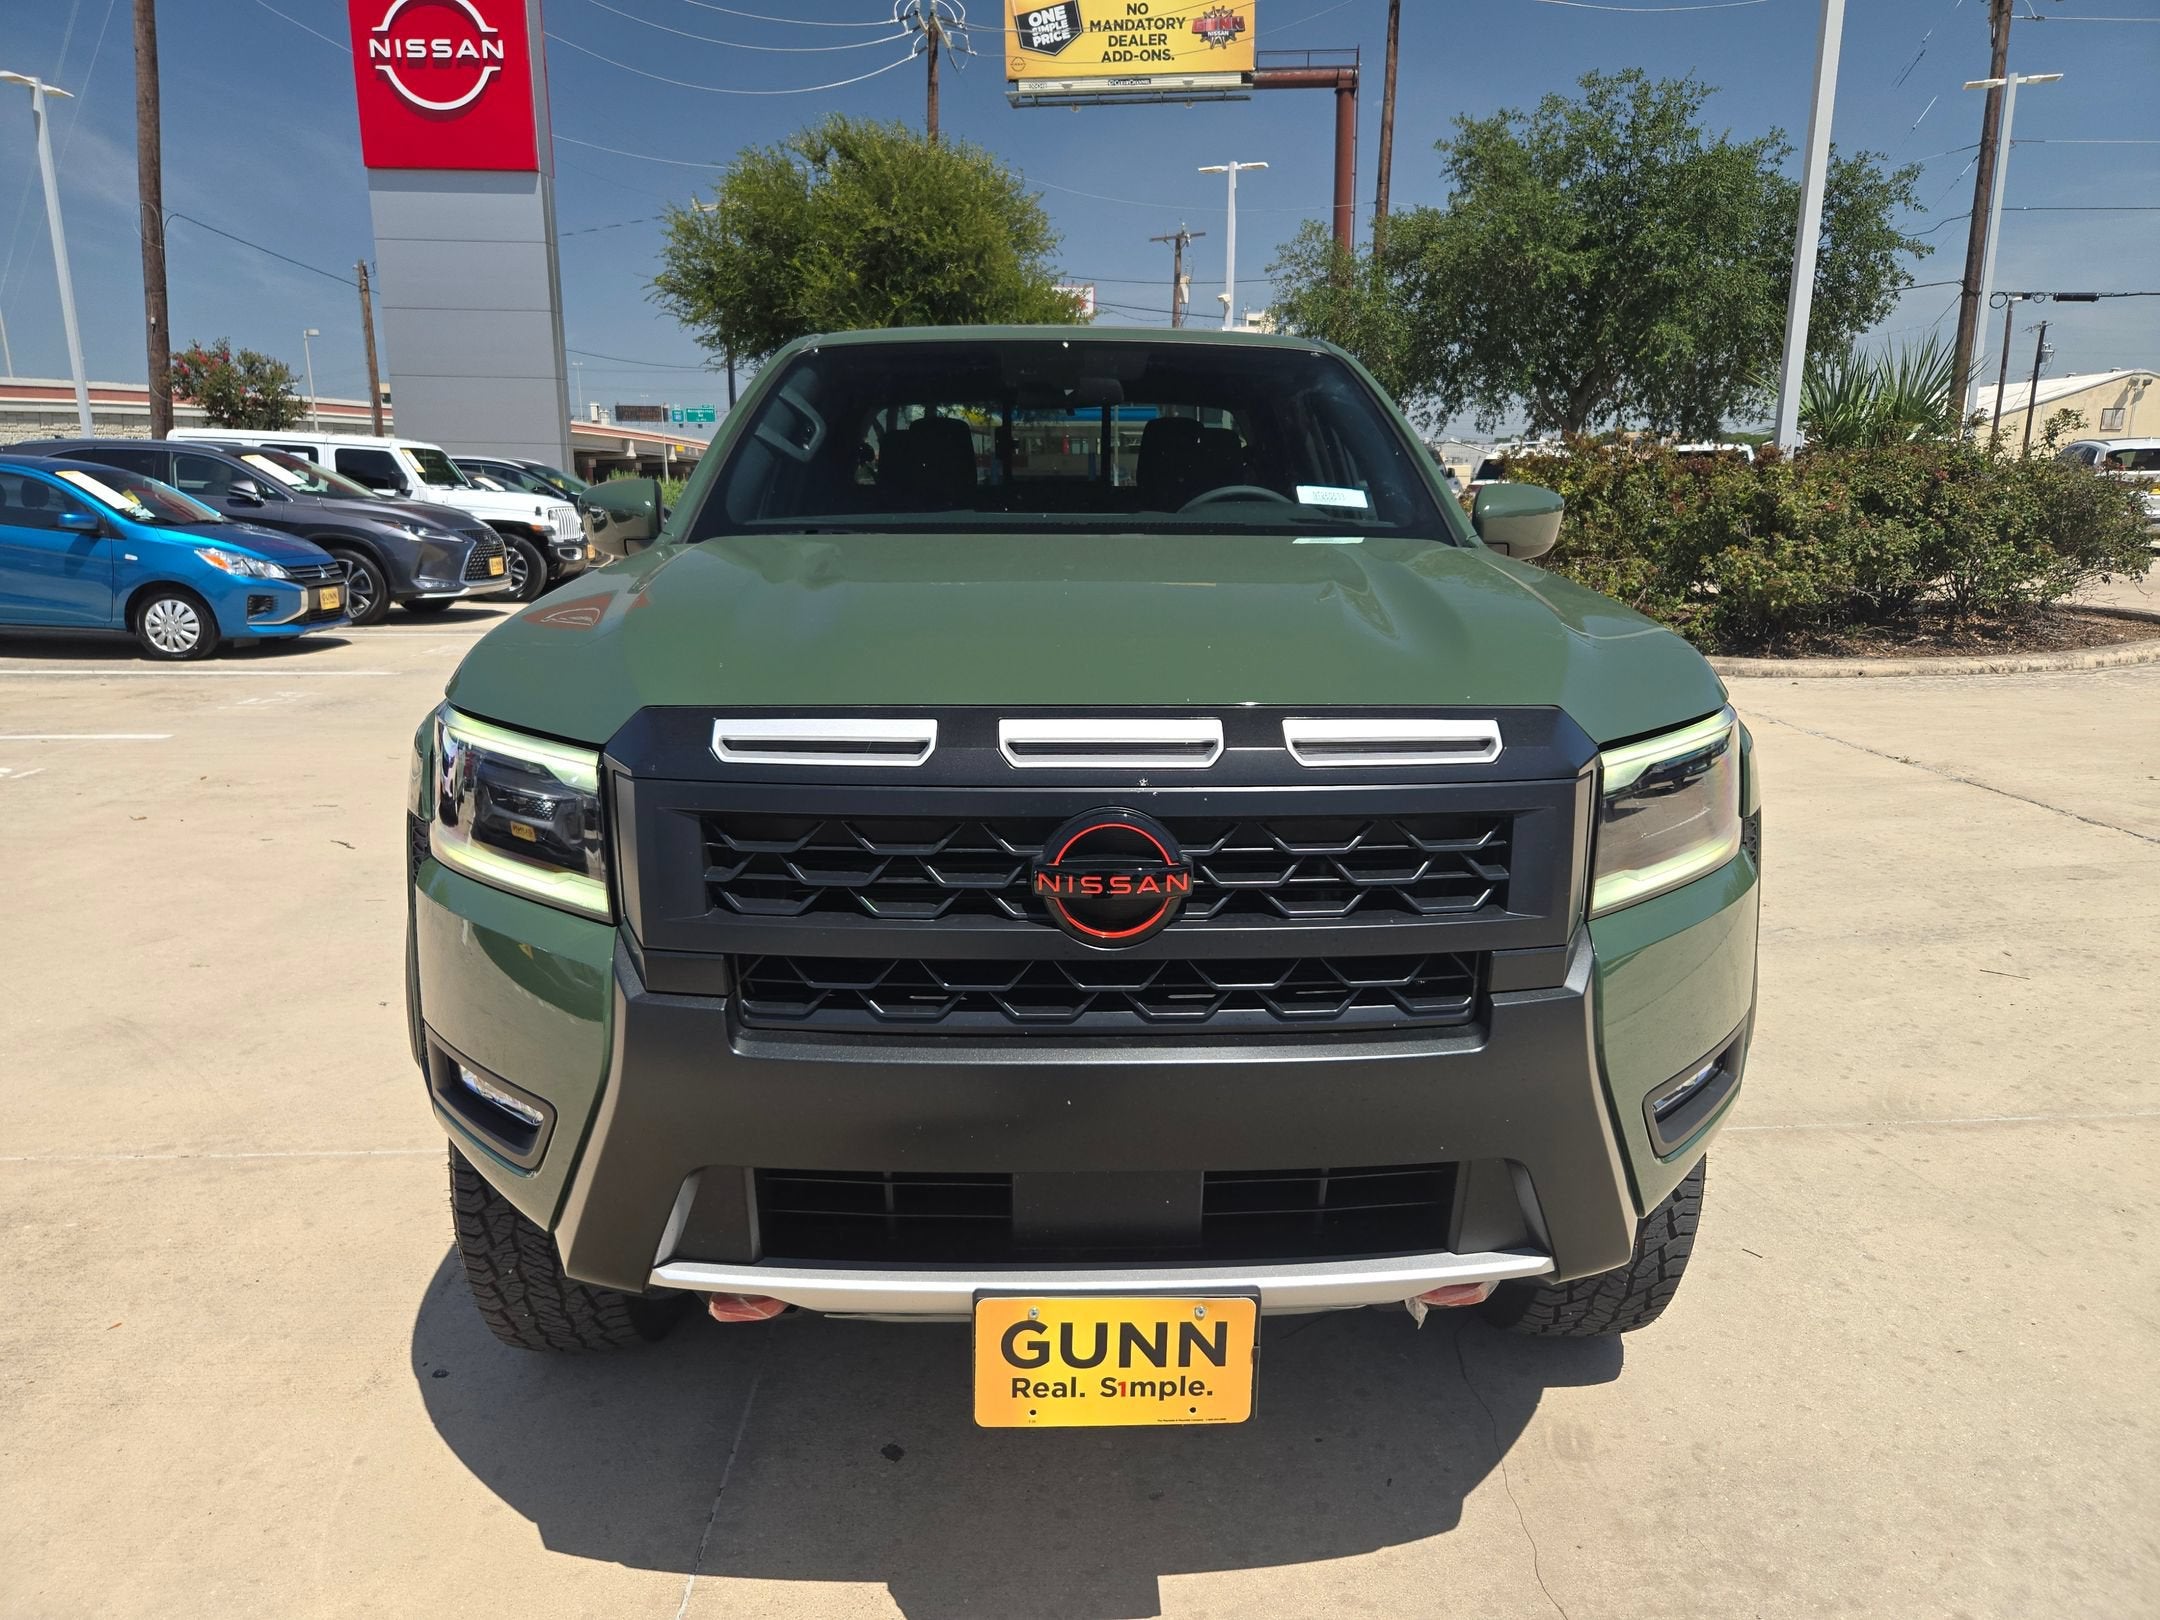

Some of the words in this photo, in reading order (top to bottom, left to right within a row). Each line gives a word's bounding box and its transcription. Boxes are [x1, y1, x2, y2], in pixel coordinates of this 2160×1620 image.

[1028, 5, 1067, 27] ONE
[1127, 3, 1148, 15] NO
[1032, 19, 1069, 36] SIMPLE
[1090, 17, 1186, 32] MANDATORY
[1033, 29, 1071, 47] PRICE
[1108, 34, 1167, 47] DEALER
[369, 38, 504, 59] NISSAN
[1101, 49, 1175, 62] ADD-ONS.
[1038, 873, 1188, 894] NISSAN
[1001, 1320, 1227, 1369] GUNN
[1012, 1377, 1085, 1398] Real.
[1100, 1375, 1213, 1401] S1mple.
